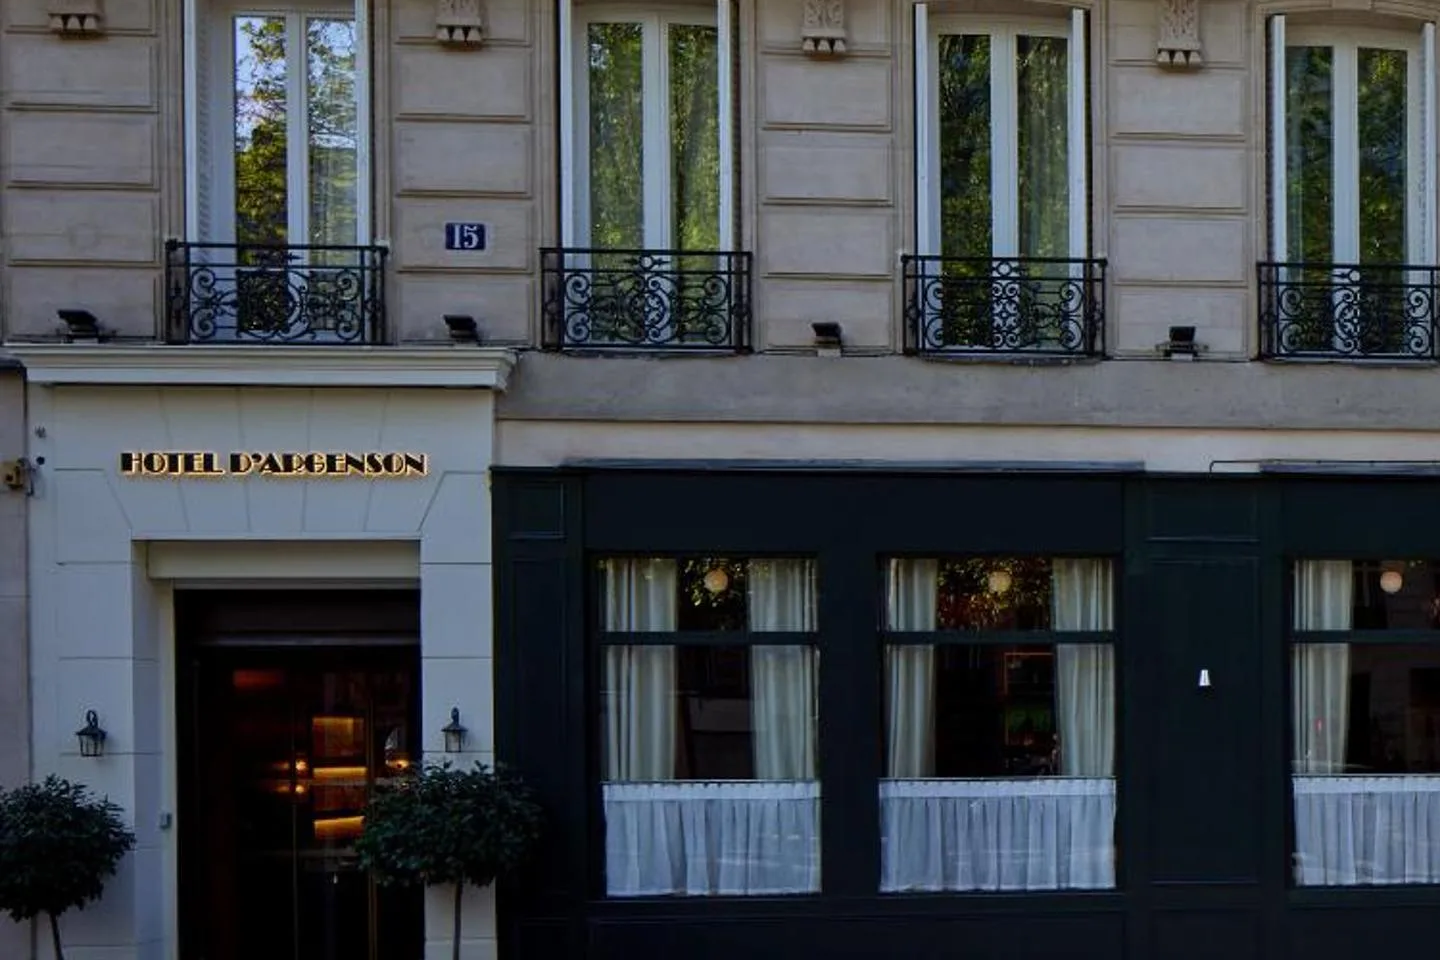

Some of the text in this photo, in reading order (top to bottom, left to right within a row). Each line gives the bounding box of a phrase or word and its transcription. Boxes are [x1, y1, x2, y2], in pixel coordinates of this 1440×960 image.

[452, 225, 479, 248] 15
[120, 451, 427, 475] HOTEL D'ARGENSON
